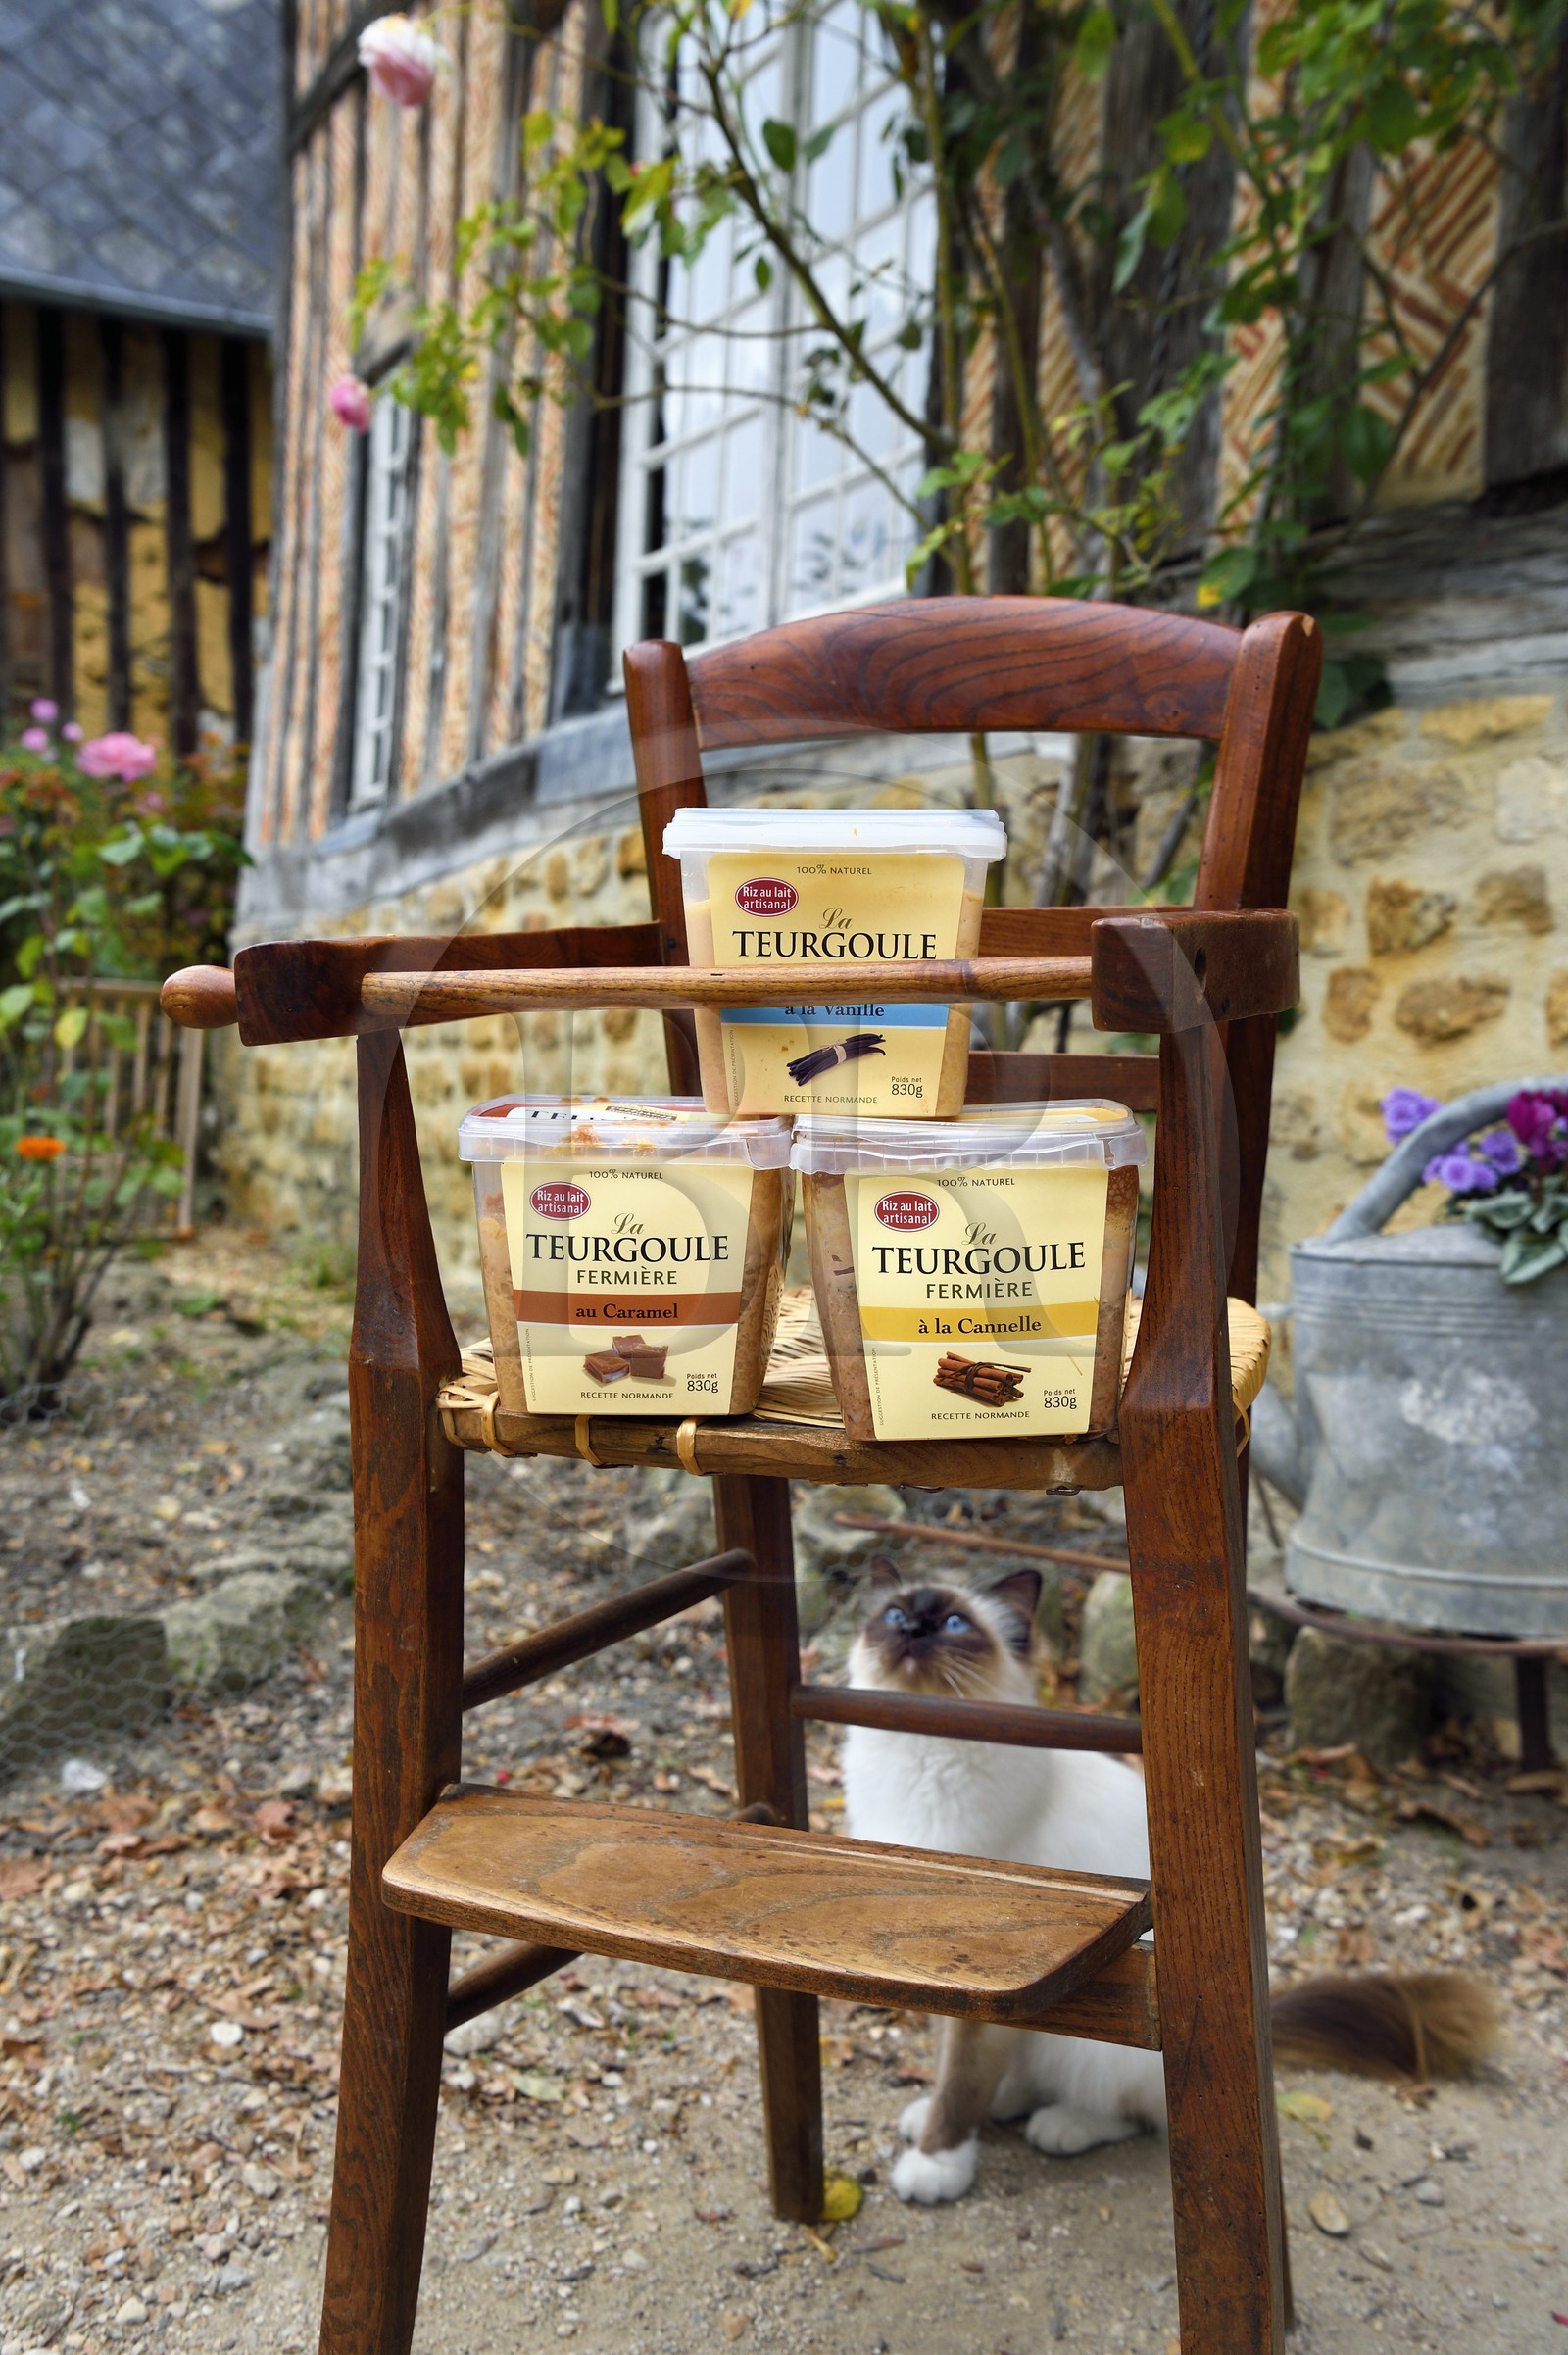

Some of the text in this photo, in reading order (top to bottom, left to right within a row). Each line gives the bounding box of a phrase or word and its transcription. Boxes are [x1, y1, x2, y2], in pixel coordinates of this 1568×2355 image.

[797, 865, 827, 875] 100%
[743, 886, 758, 897] Riz
[775, 887, 791, 899] lait
[744, 898, 790, 910] artisanal
[819, 908, 852, 930] La
[733, 930, 936, 960] TEURGOULE
[801, 1004, 816, 1016] la
[824, 1003, 884, 1017] Vanille
[891, 1084, 923, 1098] 830g
[825, 1095, 877, 1103] NORMANDE
[589, 1169, 618, 1179] 100%
[937, 1177, 1015, 1187] 100% NATUREL
[537, 1190, 584, 1203] Riz au lait
[538, 1202, 582, 1215] artisanal
[882, 1200, 932, 1212] Riz au lait
[611, 1213, 644, 1235] La
[883, 1213, 931, 1225] artisanal
[960, 1223, 997, 1245] La
[526, 1233, 729, 1263] TEURGOULE
[872, 1241, 1085, 1275] TEURGOULE
[578, 1266, 677, 1285] FERMIÈRE
[927, 1278, 1032, 1299] FERMIÈRE
[576, 1304, 678, 1319] au Caramel
[918, 1316, 1041, 1335] à la Cannelle
[687, 1380, 718, 1393] 830g
[1044, 1395, 1077, 1410] 830g
[975, 1411, 1030, 1420] NORMANDE
